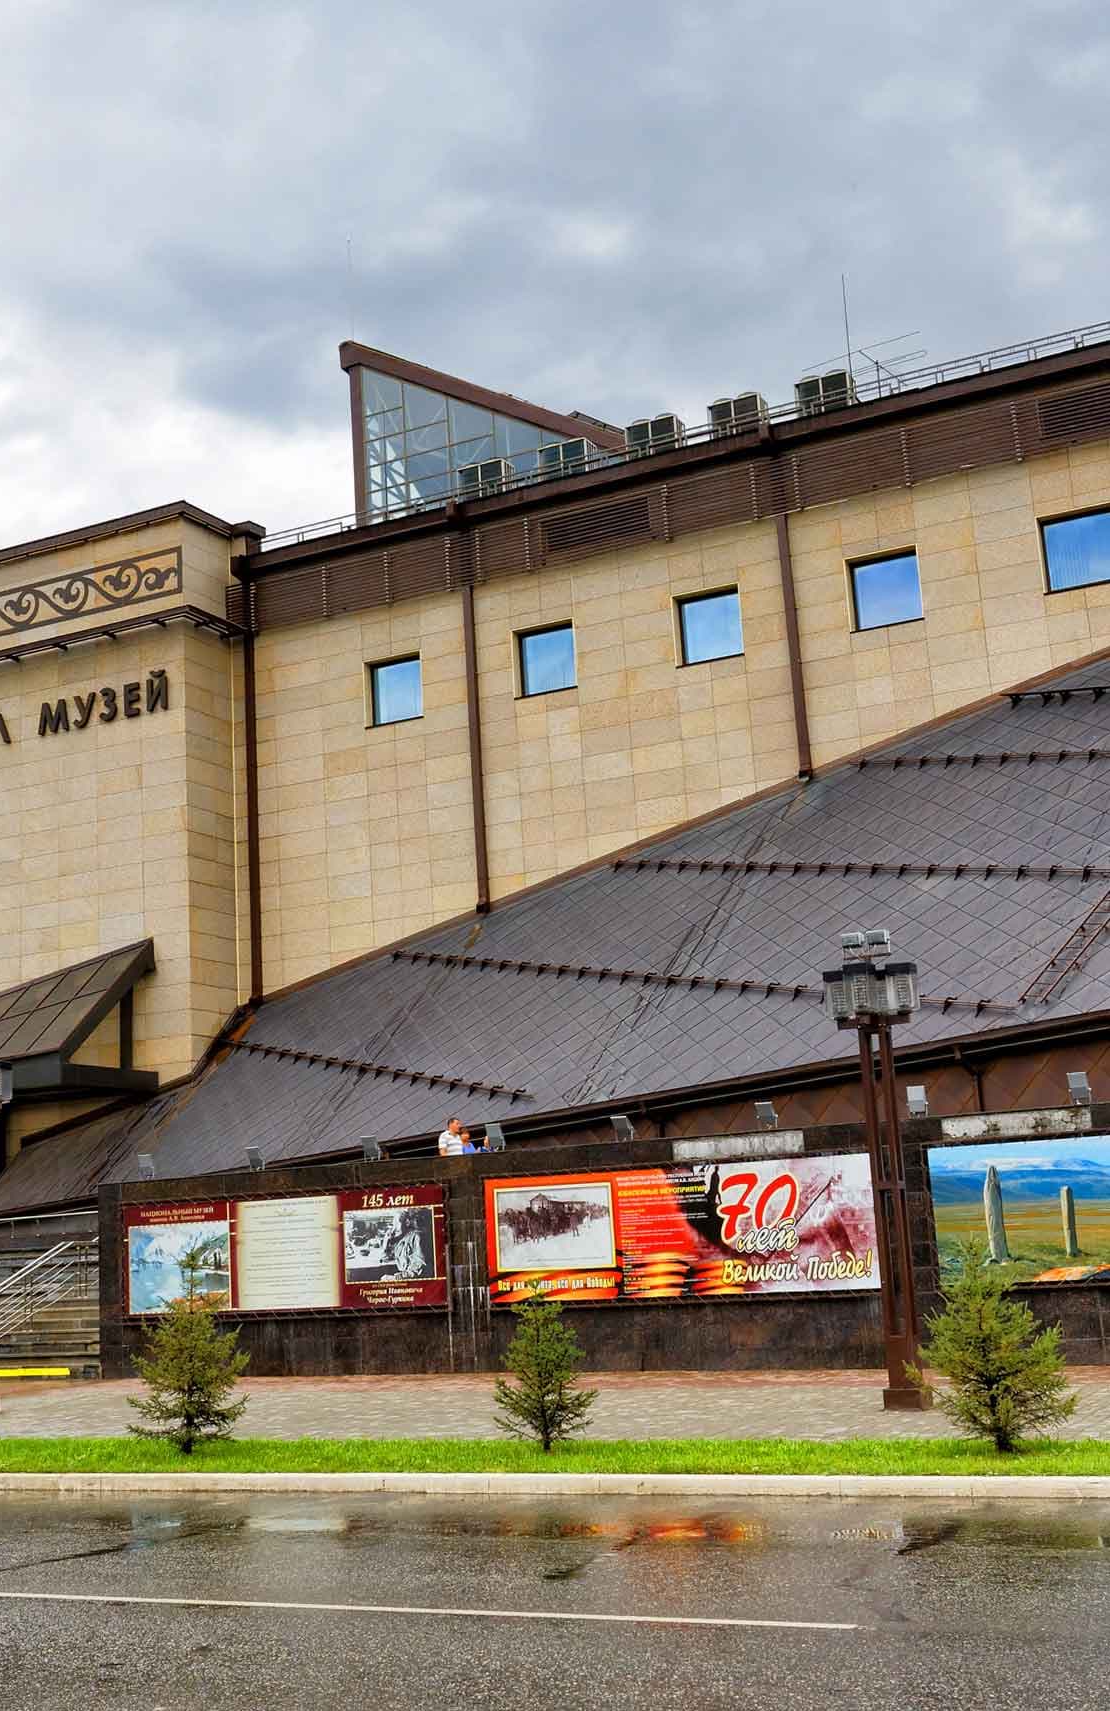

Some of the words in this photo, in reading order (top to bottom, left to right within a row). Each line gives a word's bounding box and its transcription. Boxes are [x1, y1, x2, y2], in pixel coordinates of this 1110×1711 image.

[38, 669, 169, 737] МУЗЕЙ
[362, 1193, 384, 1208] 145
[386, 1194, 414, 1207] лет
[718, 1172, 799, 1243] 70
[737, 1218, 800, 1254] лет
[722, 1254, 800, 1285] Великой
[806, 1248, 873, 1281] Победе!
